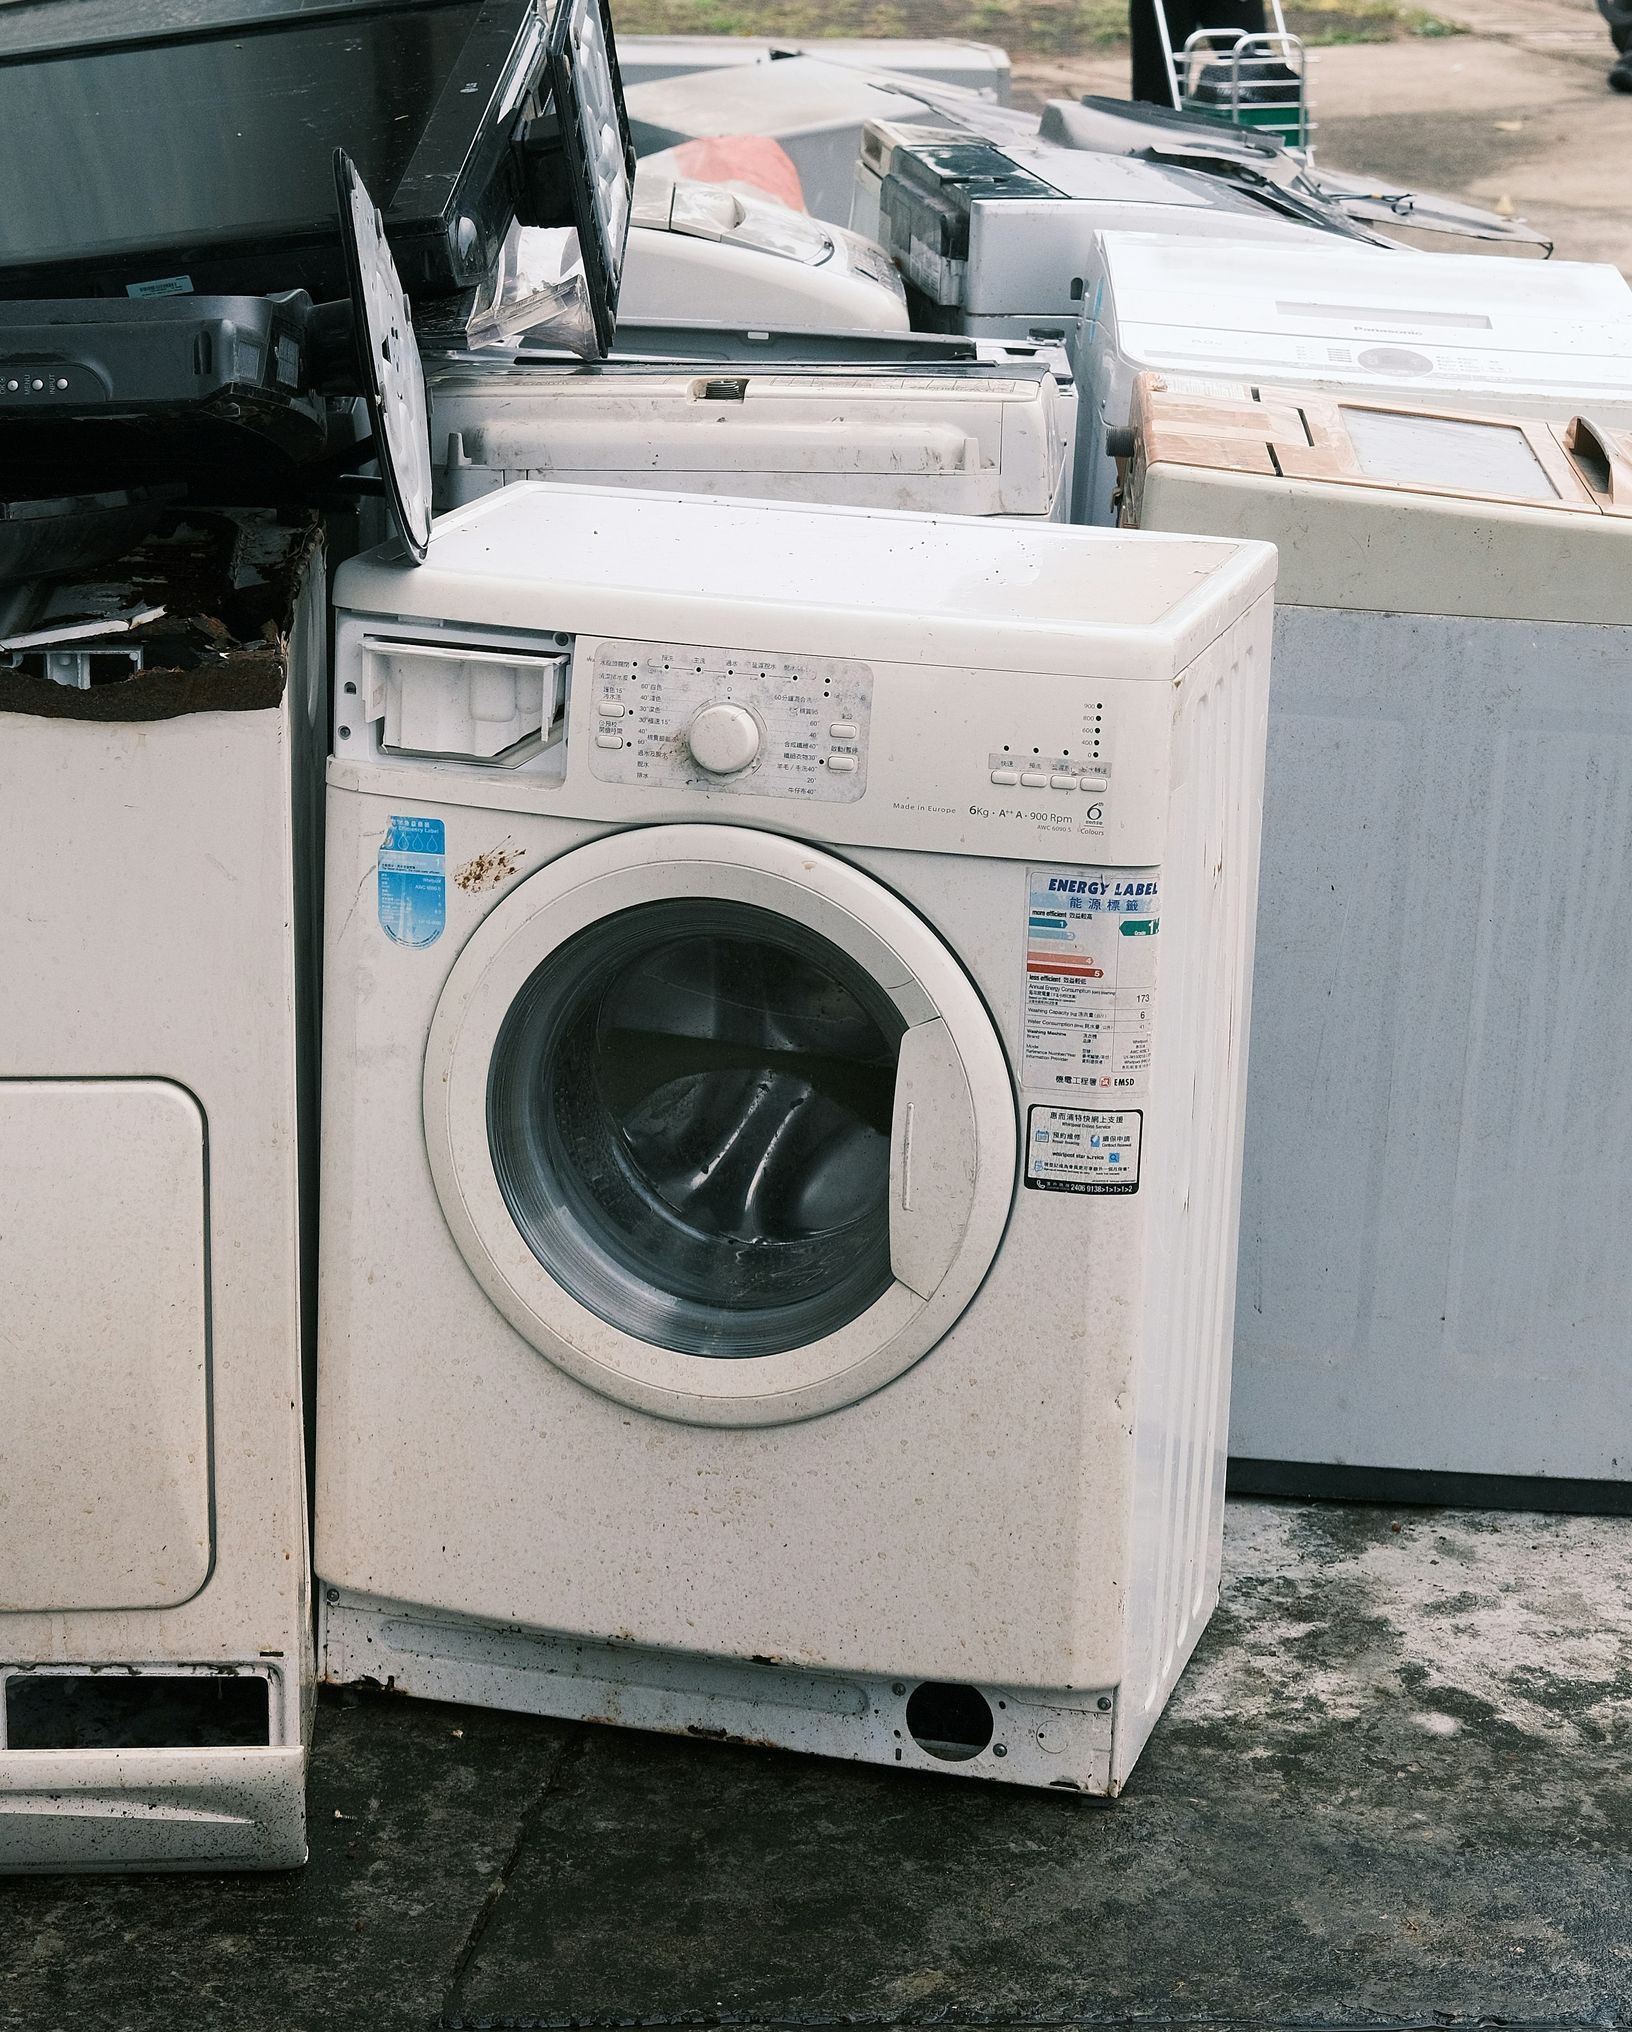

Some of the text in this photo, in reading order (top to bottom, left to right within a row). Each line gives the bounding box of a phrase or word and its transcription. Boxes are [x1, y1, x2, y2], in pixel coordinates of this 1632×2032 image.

[1353, 326, 1423, 336] Panasonic
[927, 805, 956, 814] Europe
[969, 805, 989, 818] 6Kg
[1016, 811, 1023, 819] A
[1030, 812, 1048, 821] 900
[1050, 813, 1073, 824] Rpm
[1080, 828, 1104, 836] Colours
[1048, 878, 1158, 896] ENERGY LABEL
[1069, 896, 1139, 912] 能源標籤
[1046, 910, 1067, 918] efficient
[1041, 975, 1061, 983] efficient
[1029, 983, 1044, 991] Annual
[1045, 985, 1060, 993] Energy
[1137, 994, 1150, 1003] 173
[1140, 1011, 1146, 1019] 6
[1042, 1020, 1073, 1028] Consumption
[1114, 1078, 1135, 1086] EMSD
[1071, 1184, 1086, 1192] 2406
